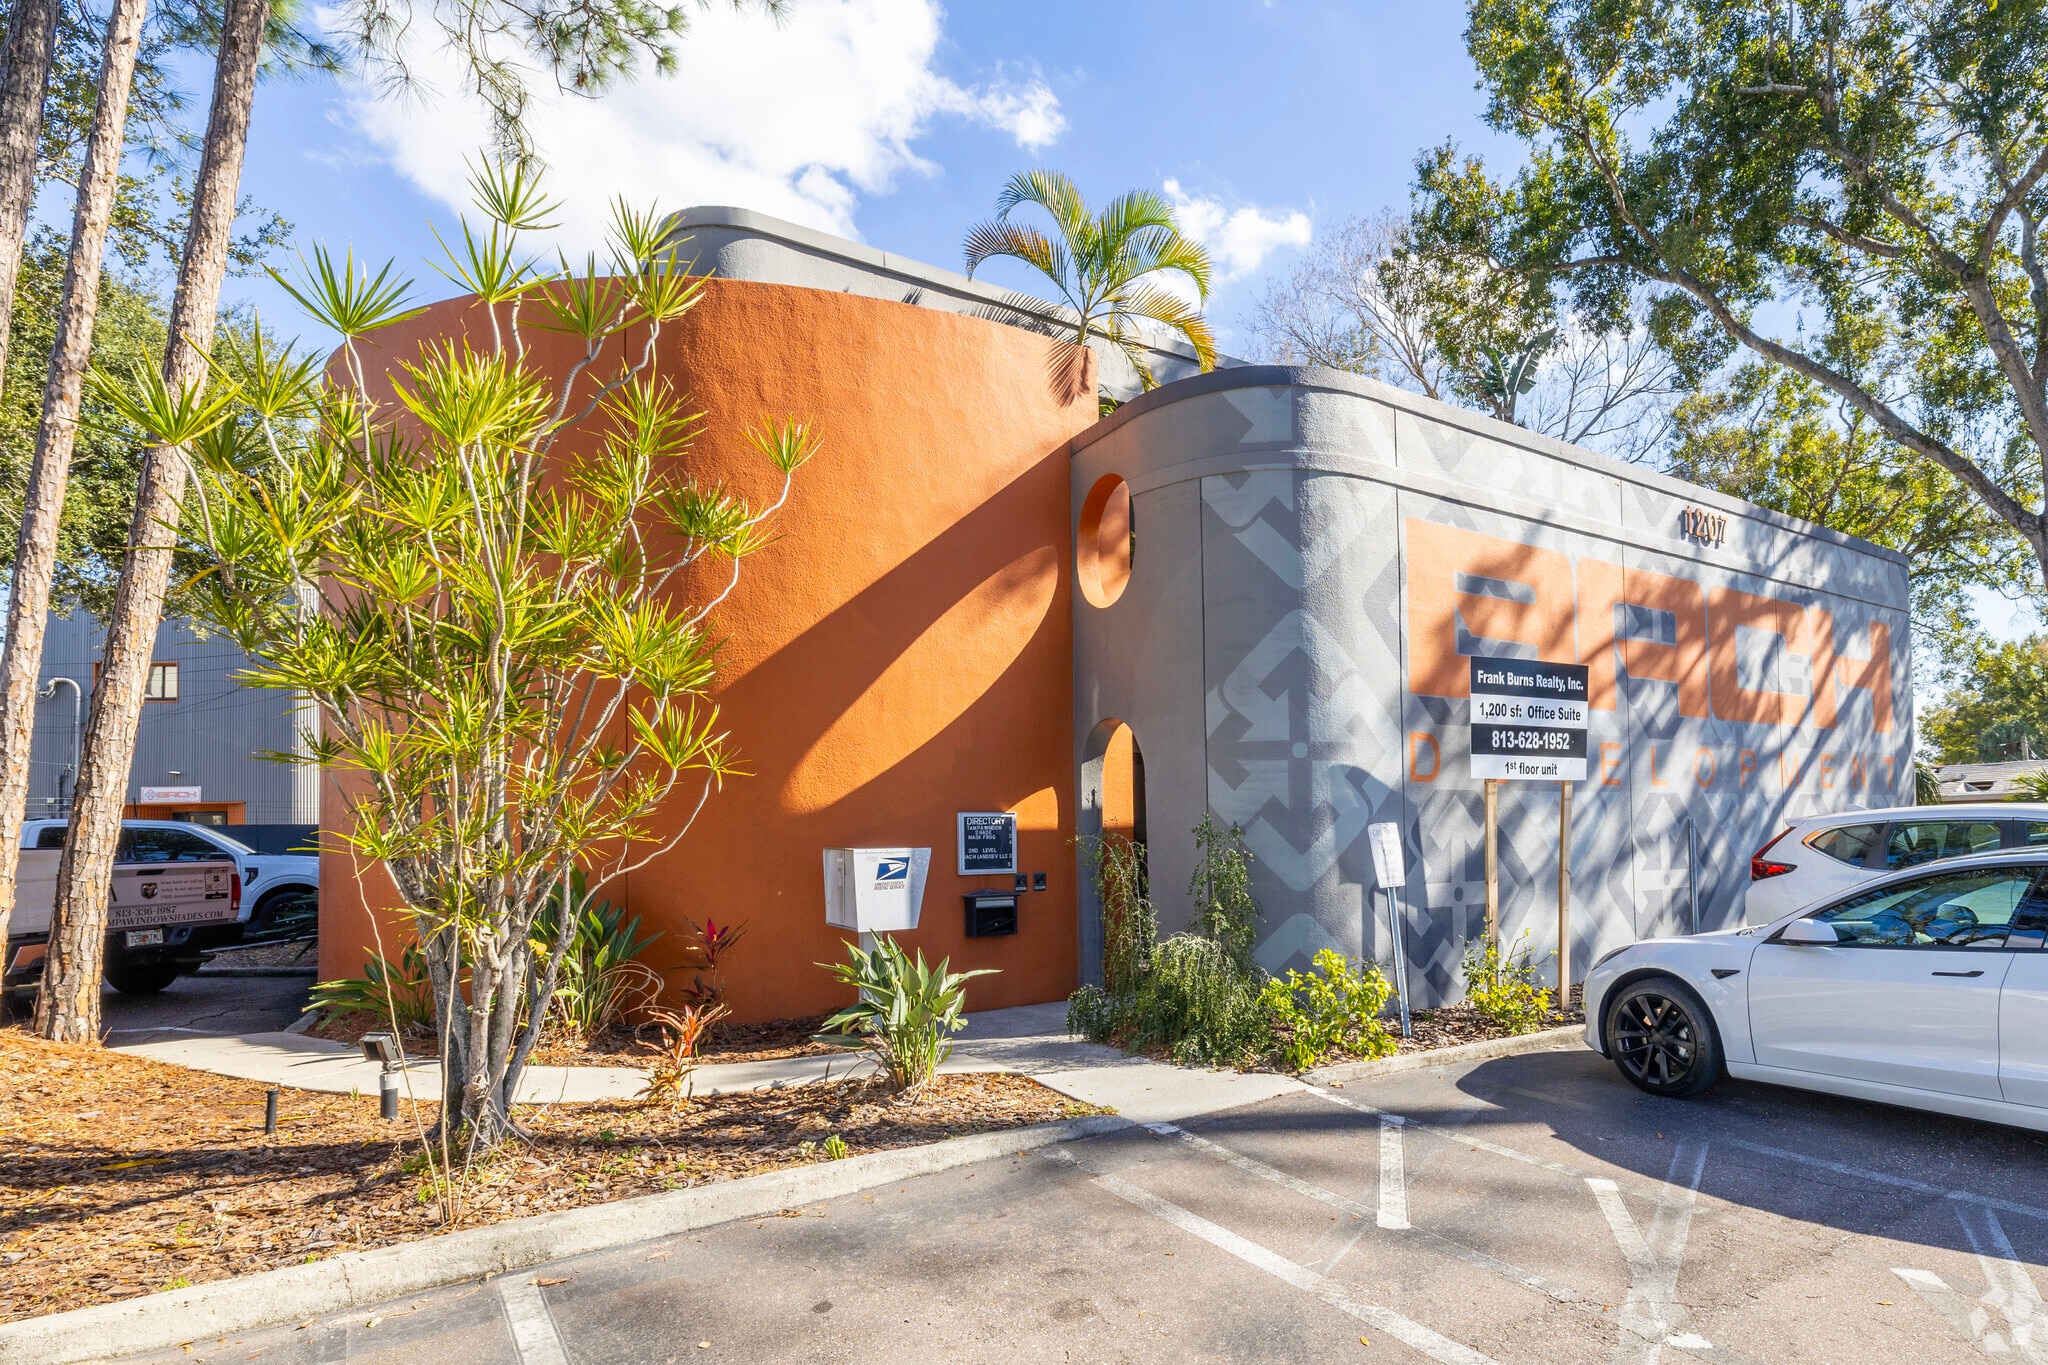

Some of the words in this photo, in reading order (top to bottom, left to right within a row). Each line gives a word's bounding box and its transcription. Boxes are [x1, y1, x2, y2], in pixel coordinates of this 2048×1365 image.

[1686, 505, 1728, 544] 1207
[1477, 670, 1505, 685] Frank
[1507, 672, 1534, 687] Burns
[1536, 674, 1566, 692] Realty,
[1567, 677, 1584, 691] Inc.
[1479, 702, 1507, 719] 1,200
[1510, 704, 1522, 718] sf:
[1527, 705, 1555, 720] Office
[1558, 707, 1581, 721] Suite
[1492, 730, 1570, 750] 813-628-1952
[1409, 732, 1896, 791] DELOPMENT
[1505, 761, 1517, 774] 1st
[1519, 763, 1539, 775] floor
[1541, 763, 1558, 775] unit
[966, 817, 1006, 825] DIRECTORY
[115, 906, 177, 918] 813-336-1987
